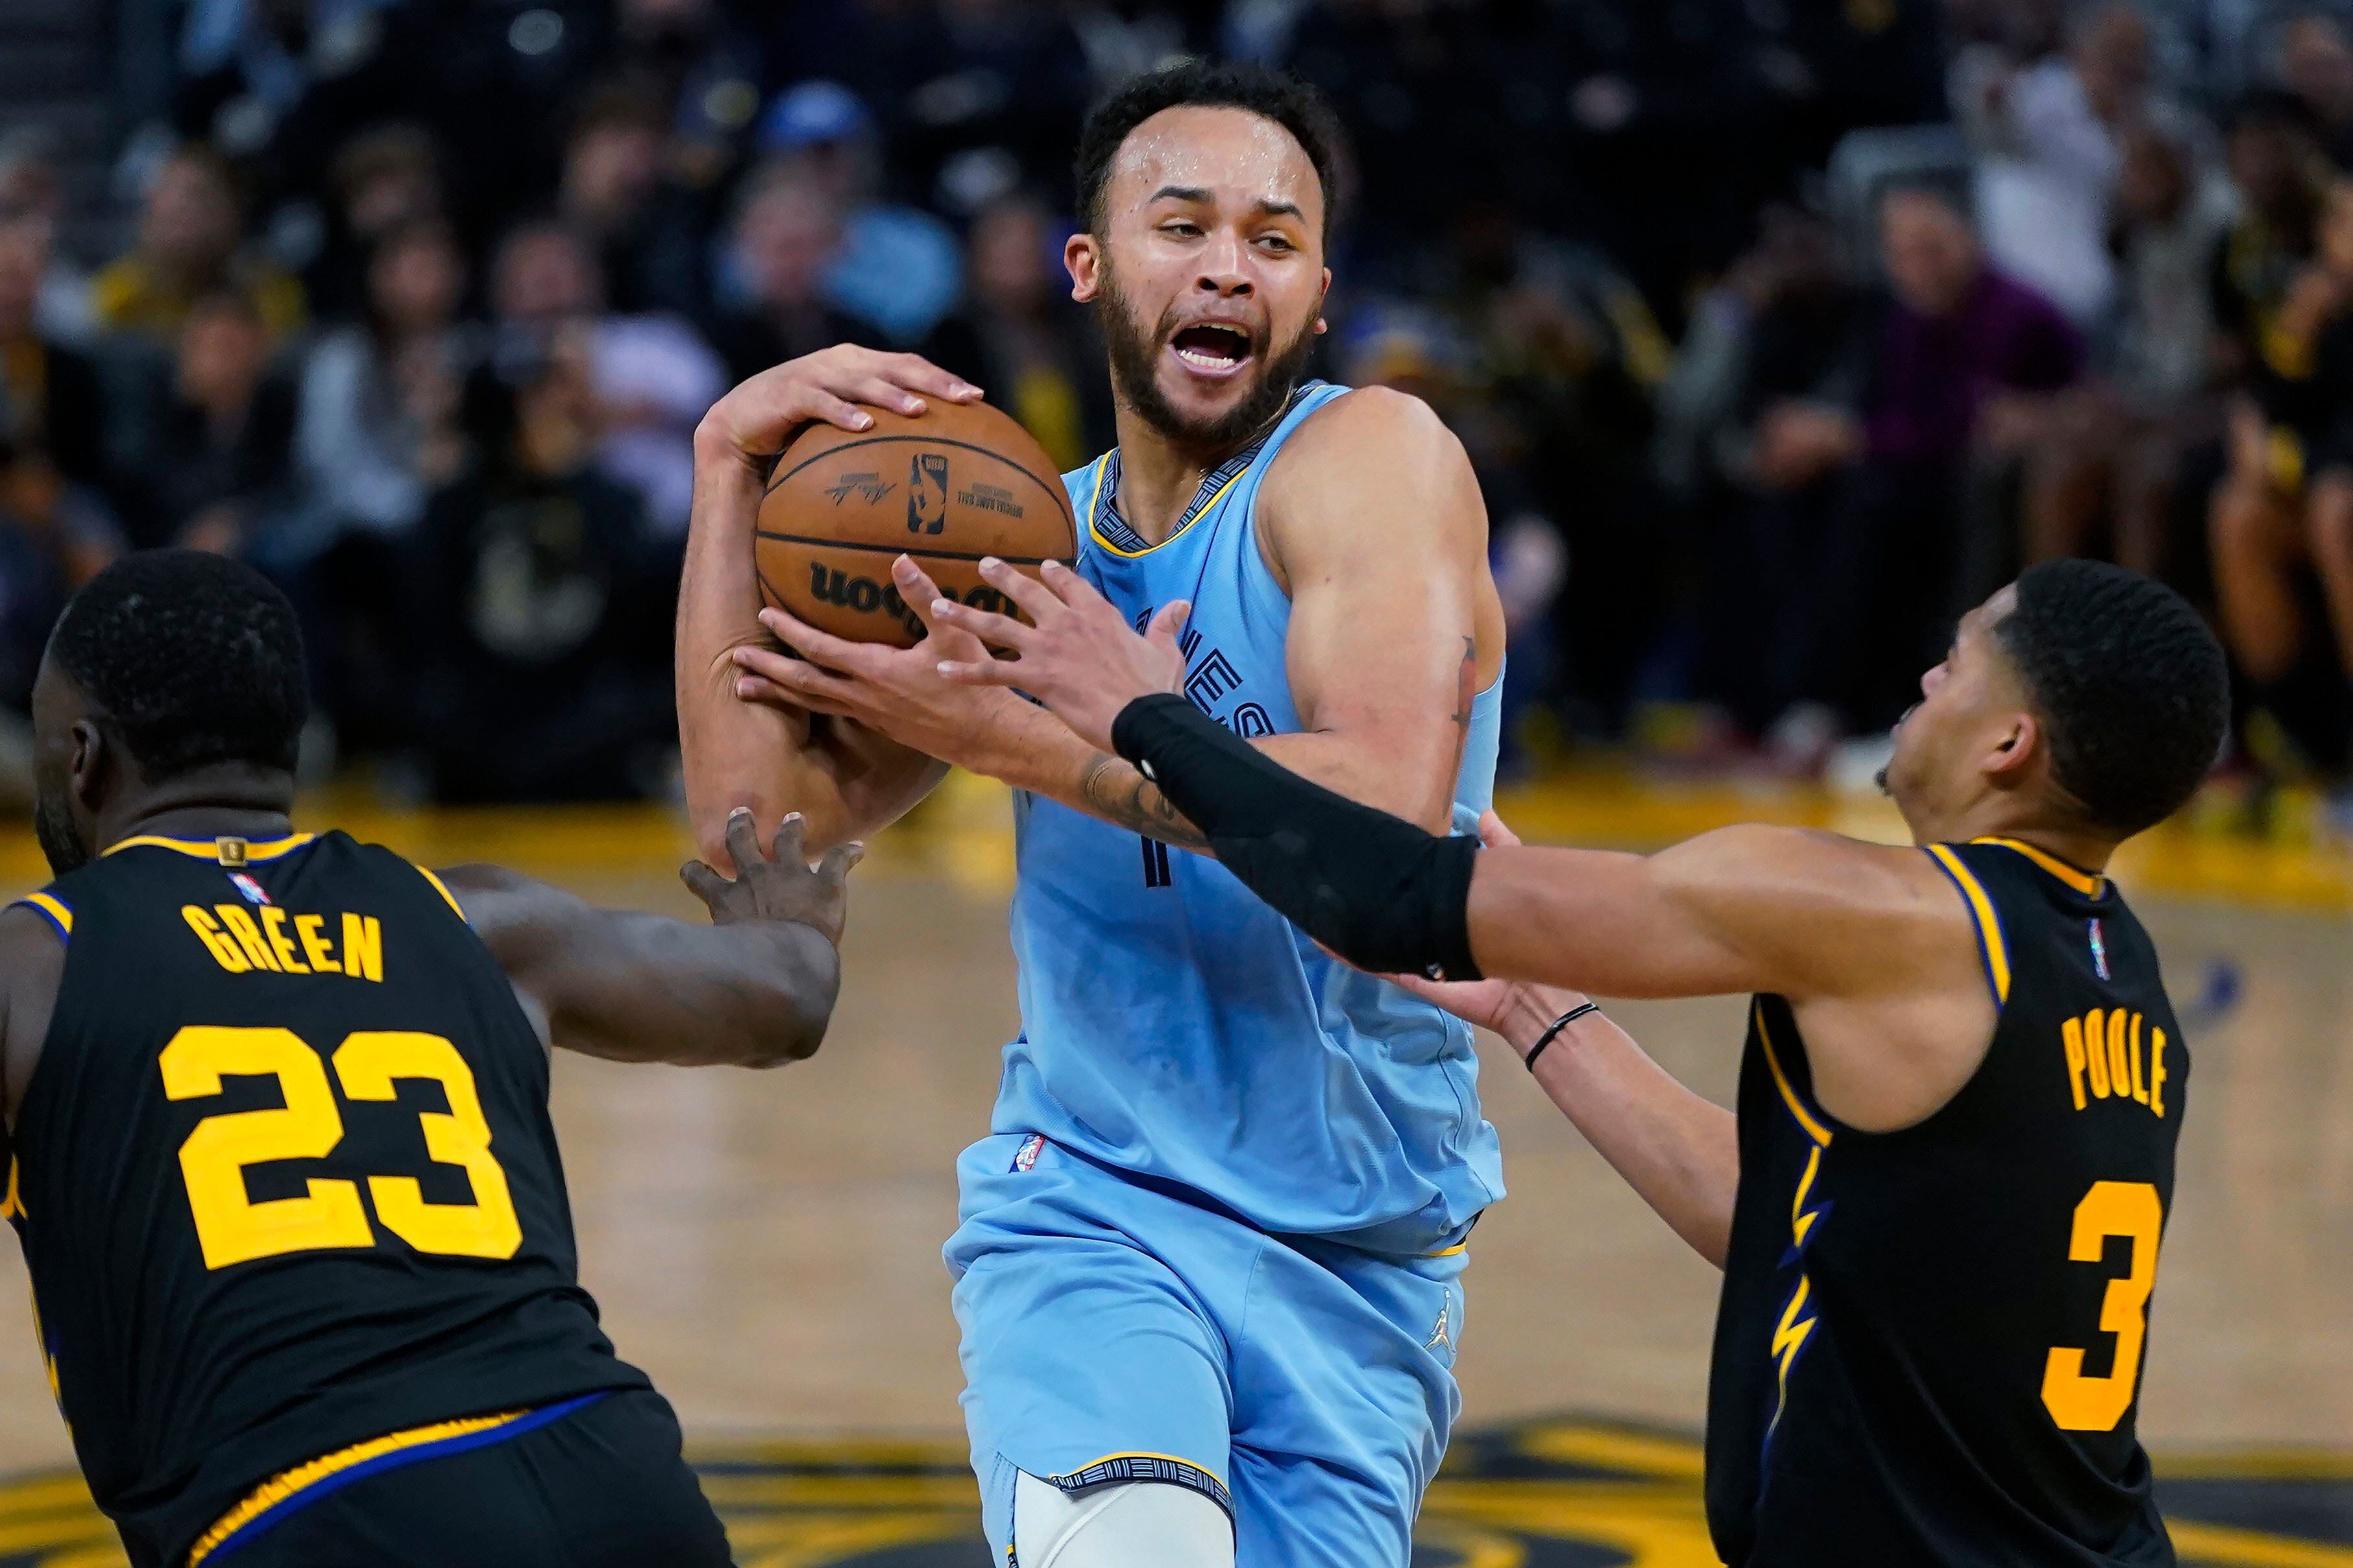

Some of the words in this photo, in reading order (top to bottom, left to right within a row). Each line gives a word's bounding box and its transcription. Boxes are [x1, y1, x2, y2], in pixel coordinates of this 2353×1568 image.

[181, 904, 384, 984] GREEN
[158, 1024, 523, 1271] 23
[2061, 1007, 2168, 1118] POOLE
[2040, 1180, 2164, 1432] 3
